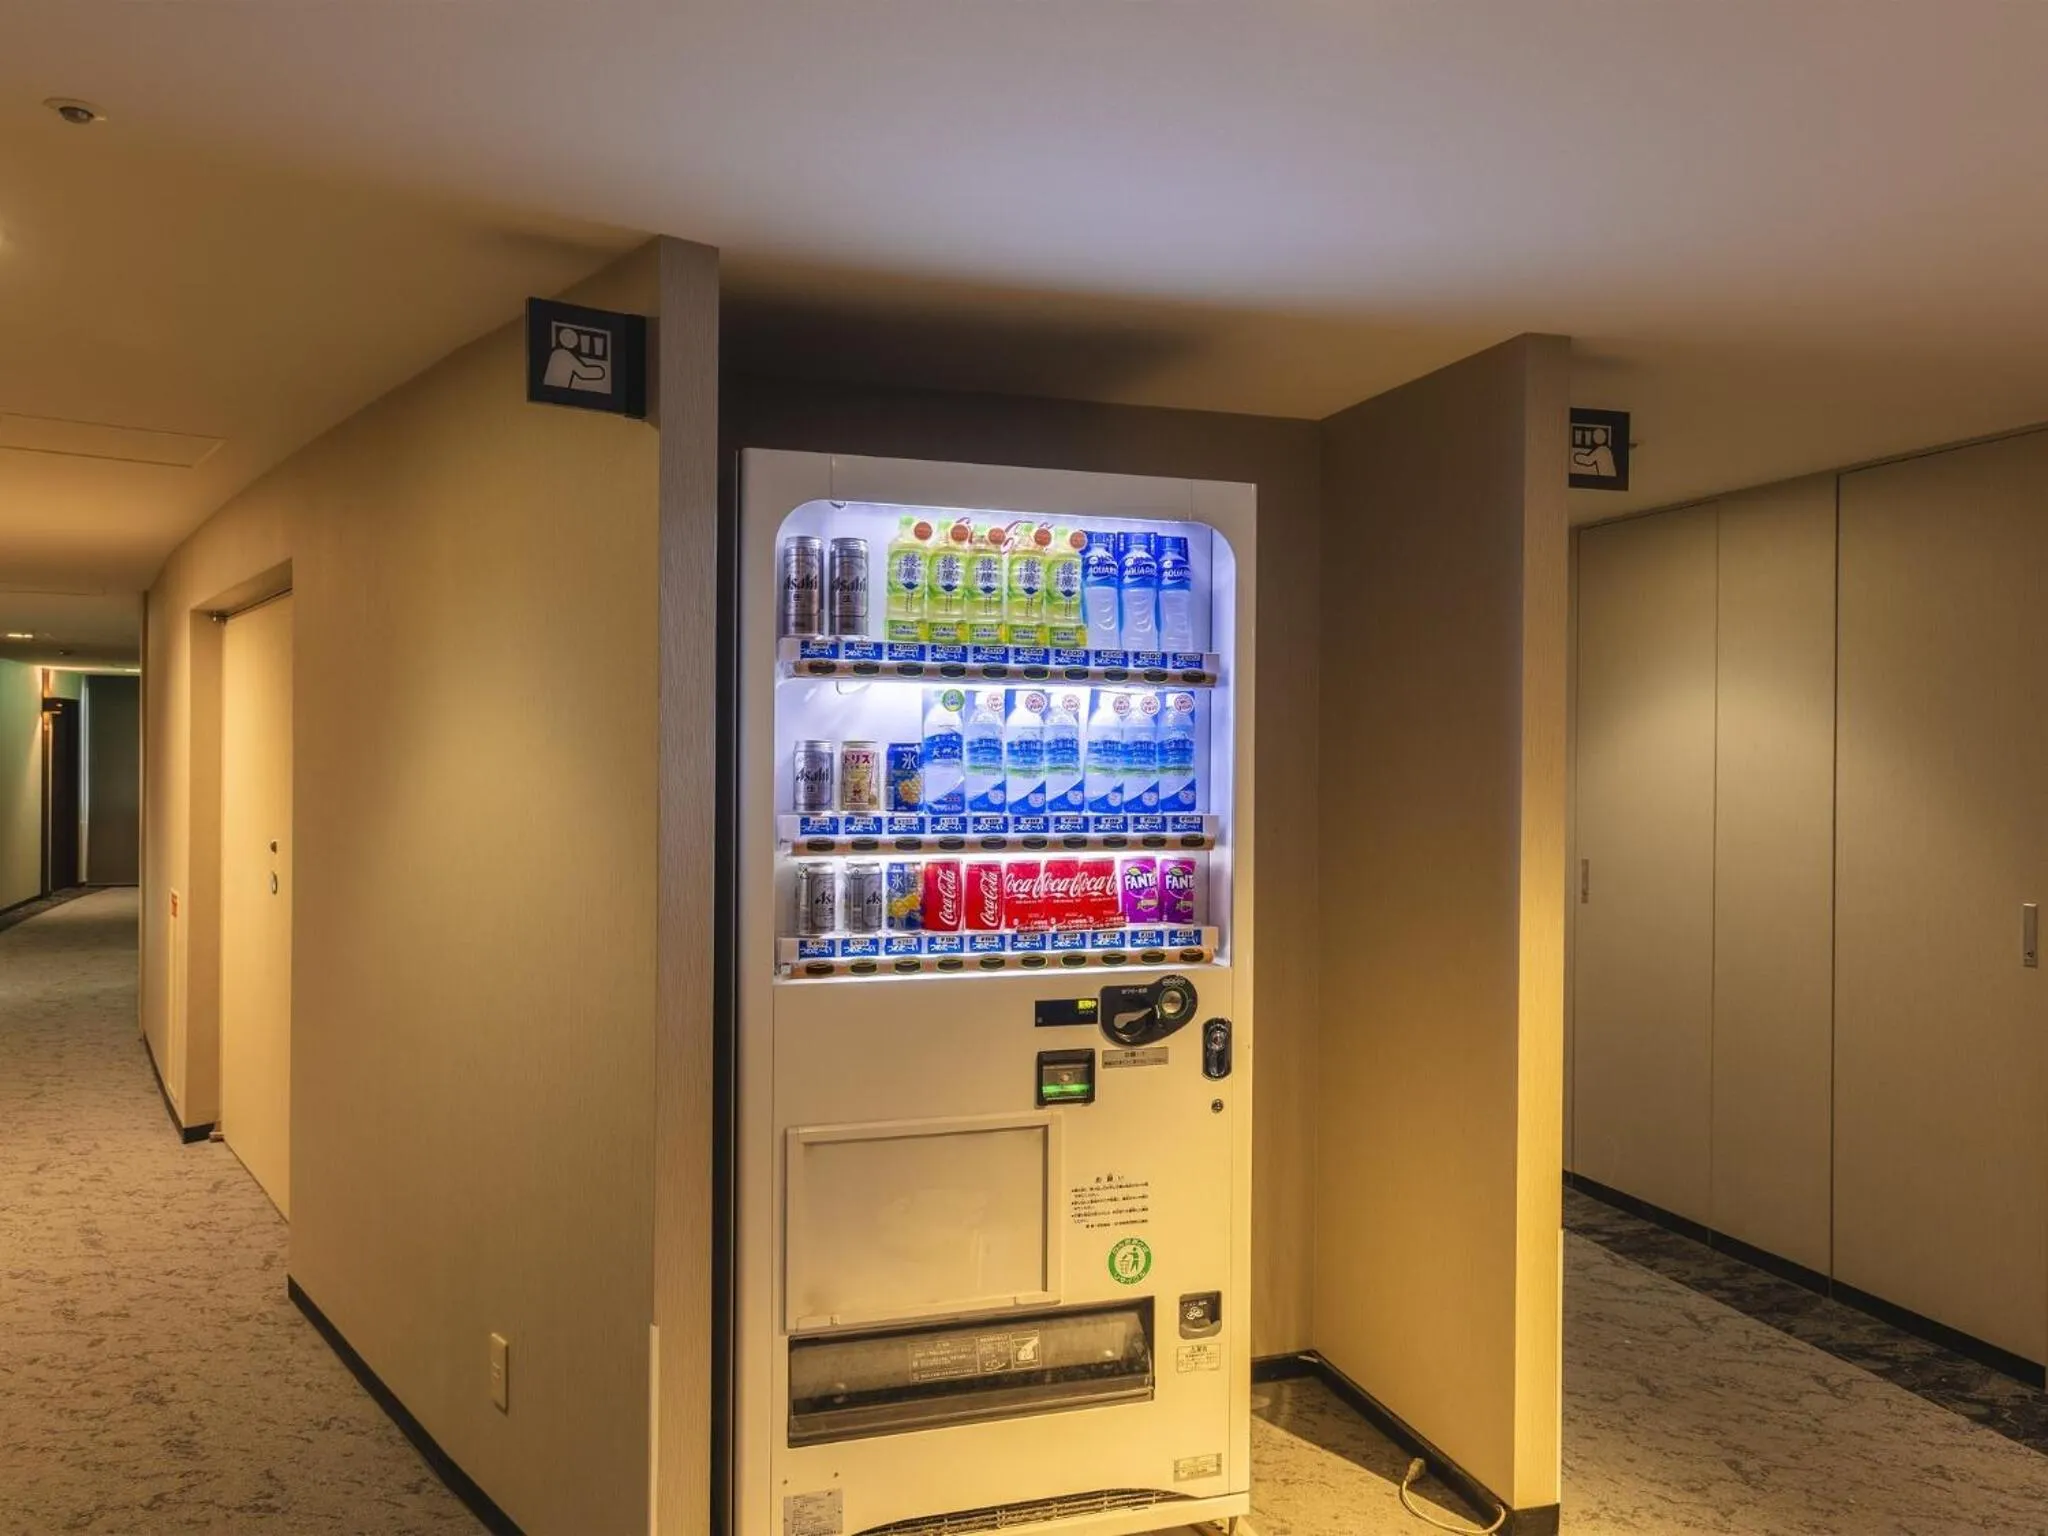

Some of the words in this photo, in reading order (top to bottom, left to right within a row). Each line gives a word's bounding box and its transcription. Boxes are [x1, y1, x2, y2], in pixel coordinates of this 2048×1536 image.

[845, 753, 872, 765] トリス
[901, 751, 917, 769] 氷
[795, 766, 829, 782] Asahi
